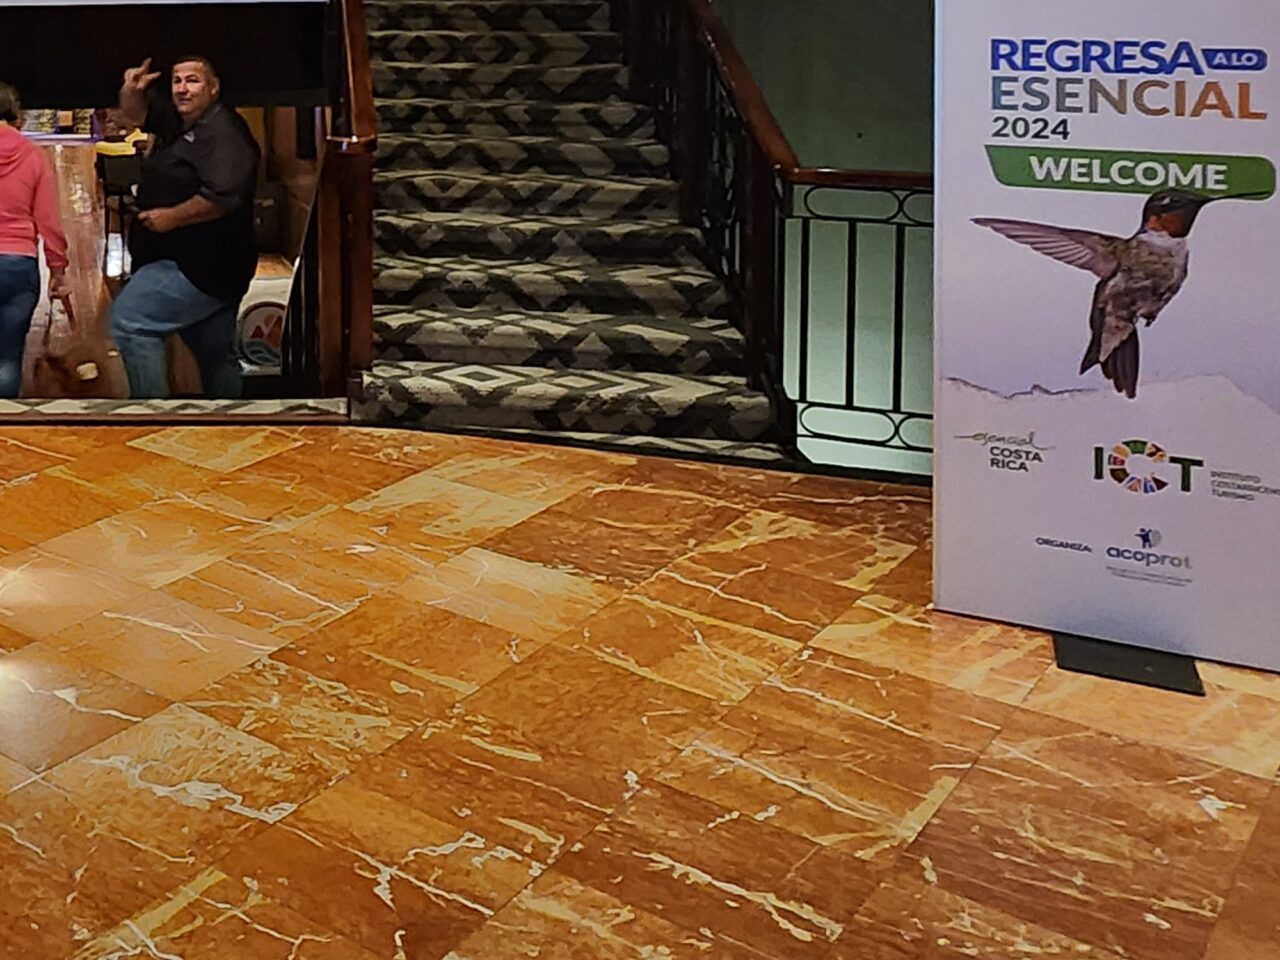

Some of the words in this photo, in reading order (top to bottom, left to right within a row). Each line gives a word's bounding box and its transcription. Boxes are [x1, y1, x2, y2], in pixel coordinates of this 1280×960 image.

[991, 38, 1205, 75] REGRESA
[1212, 52, 1229, 66] A
[1231, 52, 1259, 67] LO
[991, 76, 1268, 120] ESENCIAL
[991, 116, 1070, 140] 2024
[1029, 155, 1228, 189] WELCOME
[989, 445, 1044, 463] COSTA
[989, 457, 1029, 472] RICA
[1093, 439, 1205, 494] ICT
[1106, 546, 1193, 569] acoprot
